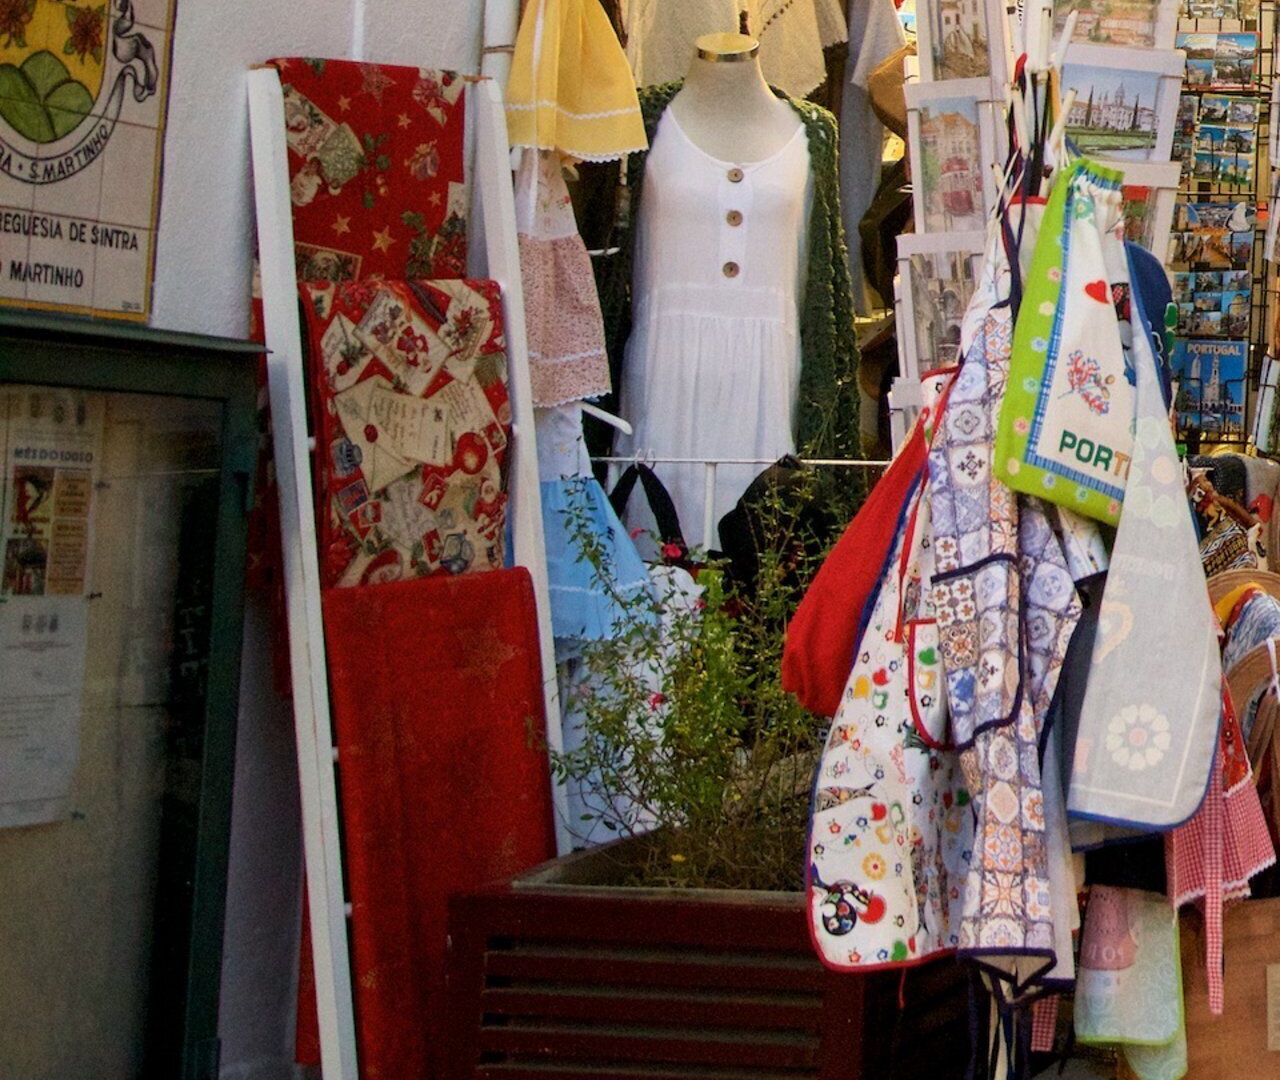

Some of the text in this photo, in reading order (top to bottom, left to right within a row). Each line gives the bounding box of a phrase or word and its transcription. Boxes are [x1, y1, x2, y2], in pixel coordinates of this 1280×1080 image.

[69, 222, 87, 243] DE
[91, 224, 139, 251] SINTRA
[10, 260, 84, 289] MARTINHO
[1187, 343, 1241, 356] PORTUGAL
[1059, 429, 1131, 481] PORT
